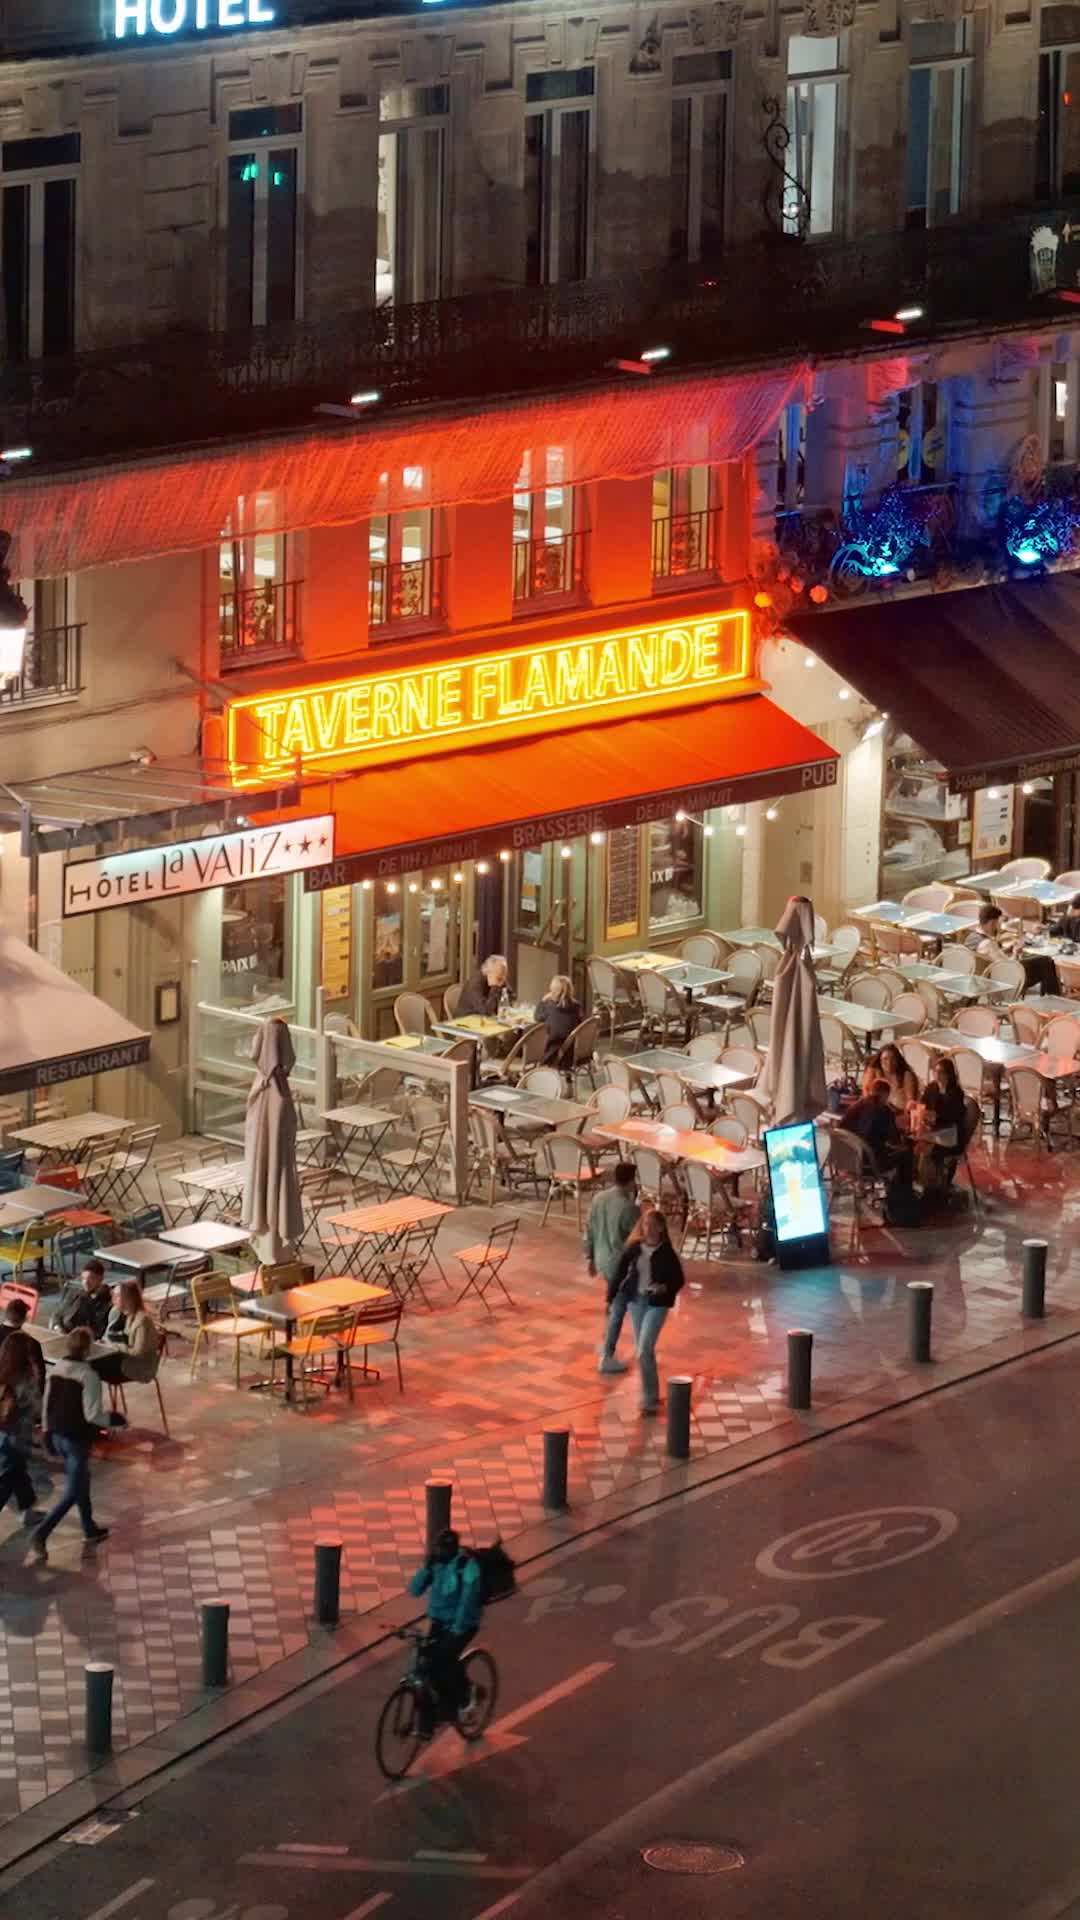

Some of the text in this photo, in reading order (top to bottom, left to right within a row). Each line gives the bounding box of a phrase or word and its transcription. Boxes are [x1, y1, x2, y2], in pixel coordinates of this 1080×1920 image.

[256, 623, 718, 759] TAVERNE FLAMANDE
[802, 763, 835, 787] PUB
[513, 811, 605, 847] BRASSERIE
[70, 871, 153, 904] HÔTEL
[308, 863, 346, 889] BAR
[36, 1045, 141, 1084] RESTAURANT
[612, 1595, 888, 1670] BUS
